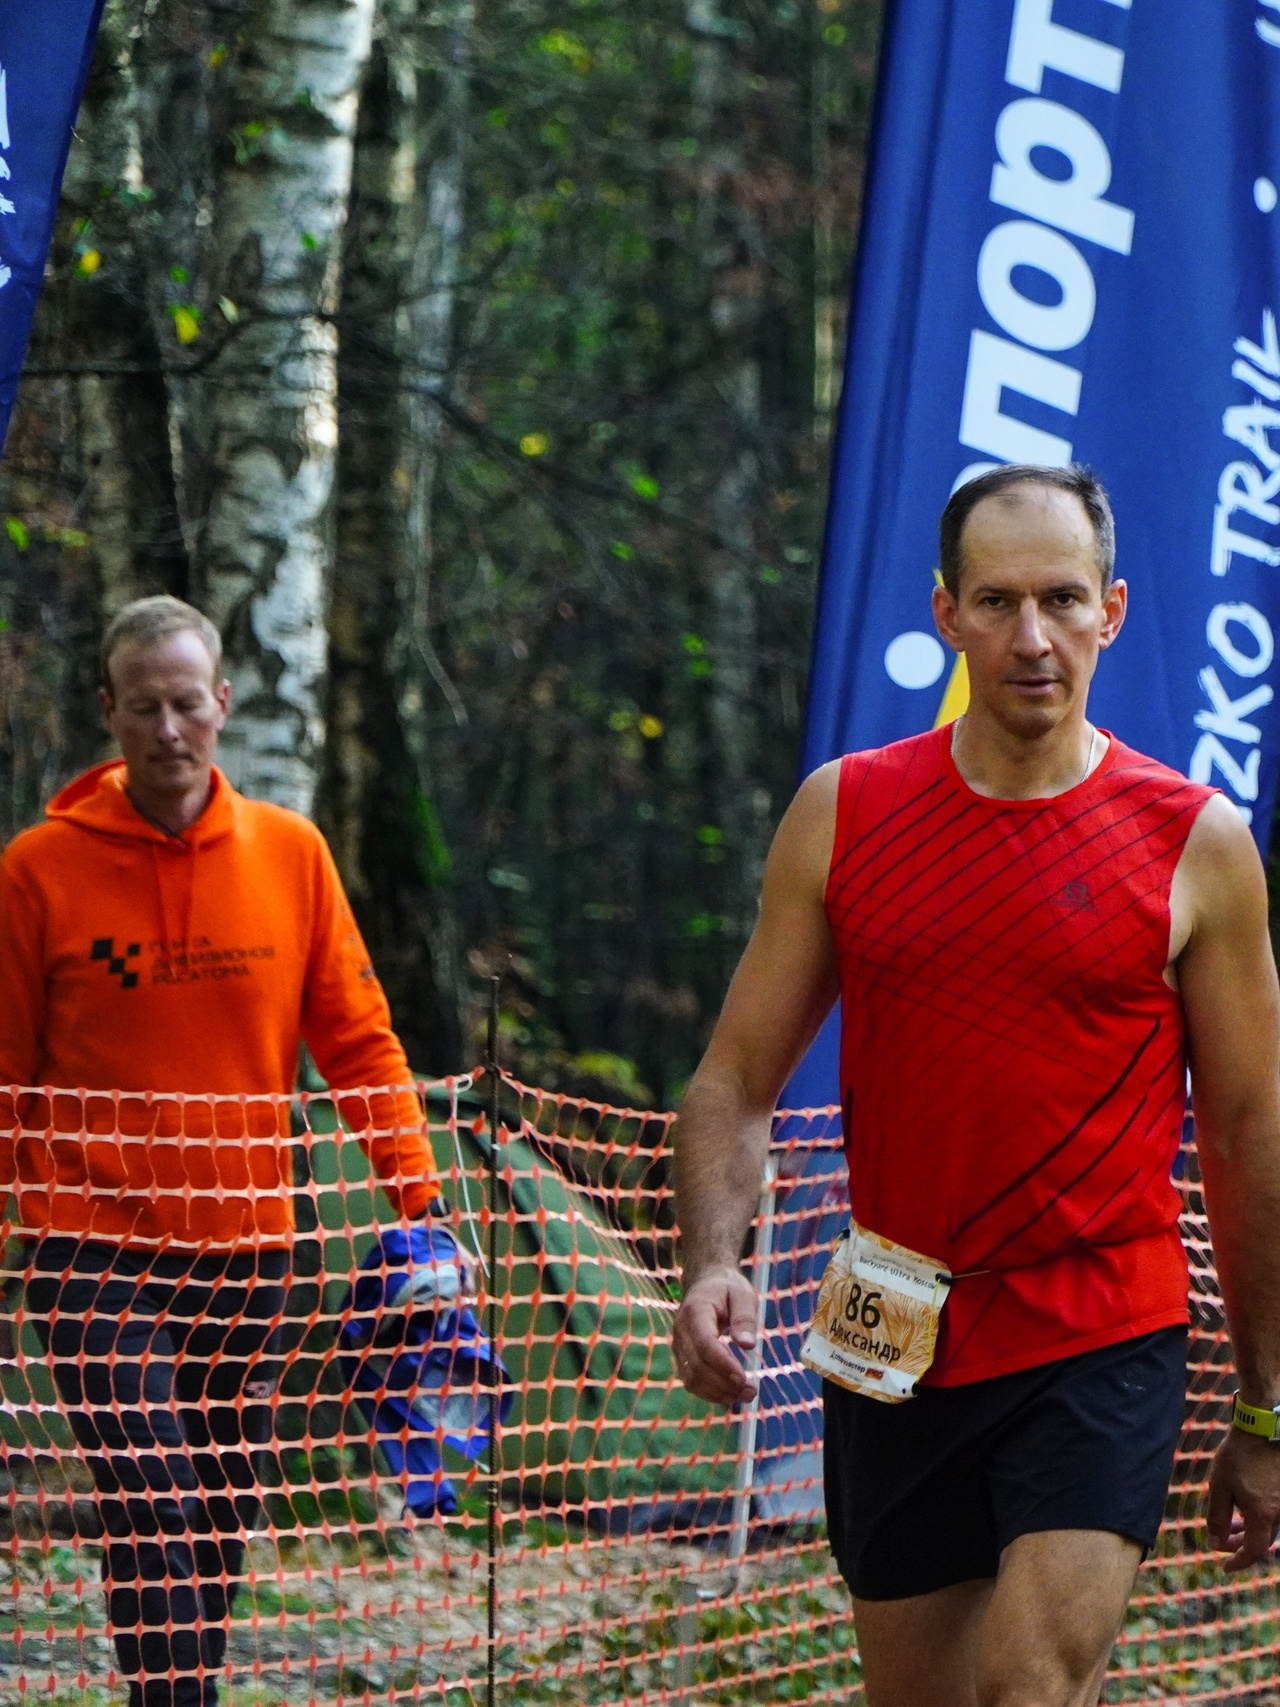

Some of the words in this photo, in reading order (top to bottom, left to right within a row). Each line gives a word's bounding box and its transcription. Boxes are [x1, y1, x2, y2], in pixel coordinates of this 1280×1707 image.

[950, 0, 1134, 500] порт
[1189, 601, 1274, 826] ZKO
[845, 1283, 882, 1329] 86
